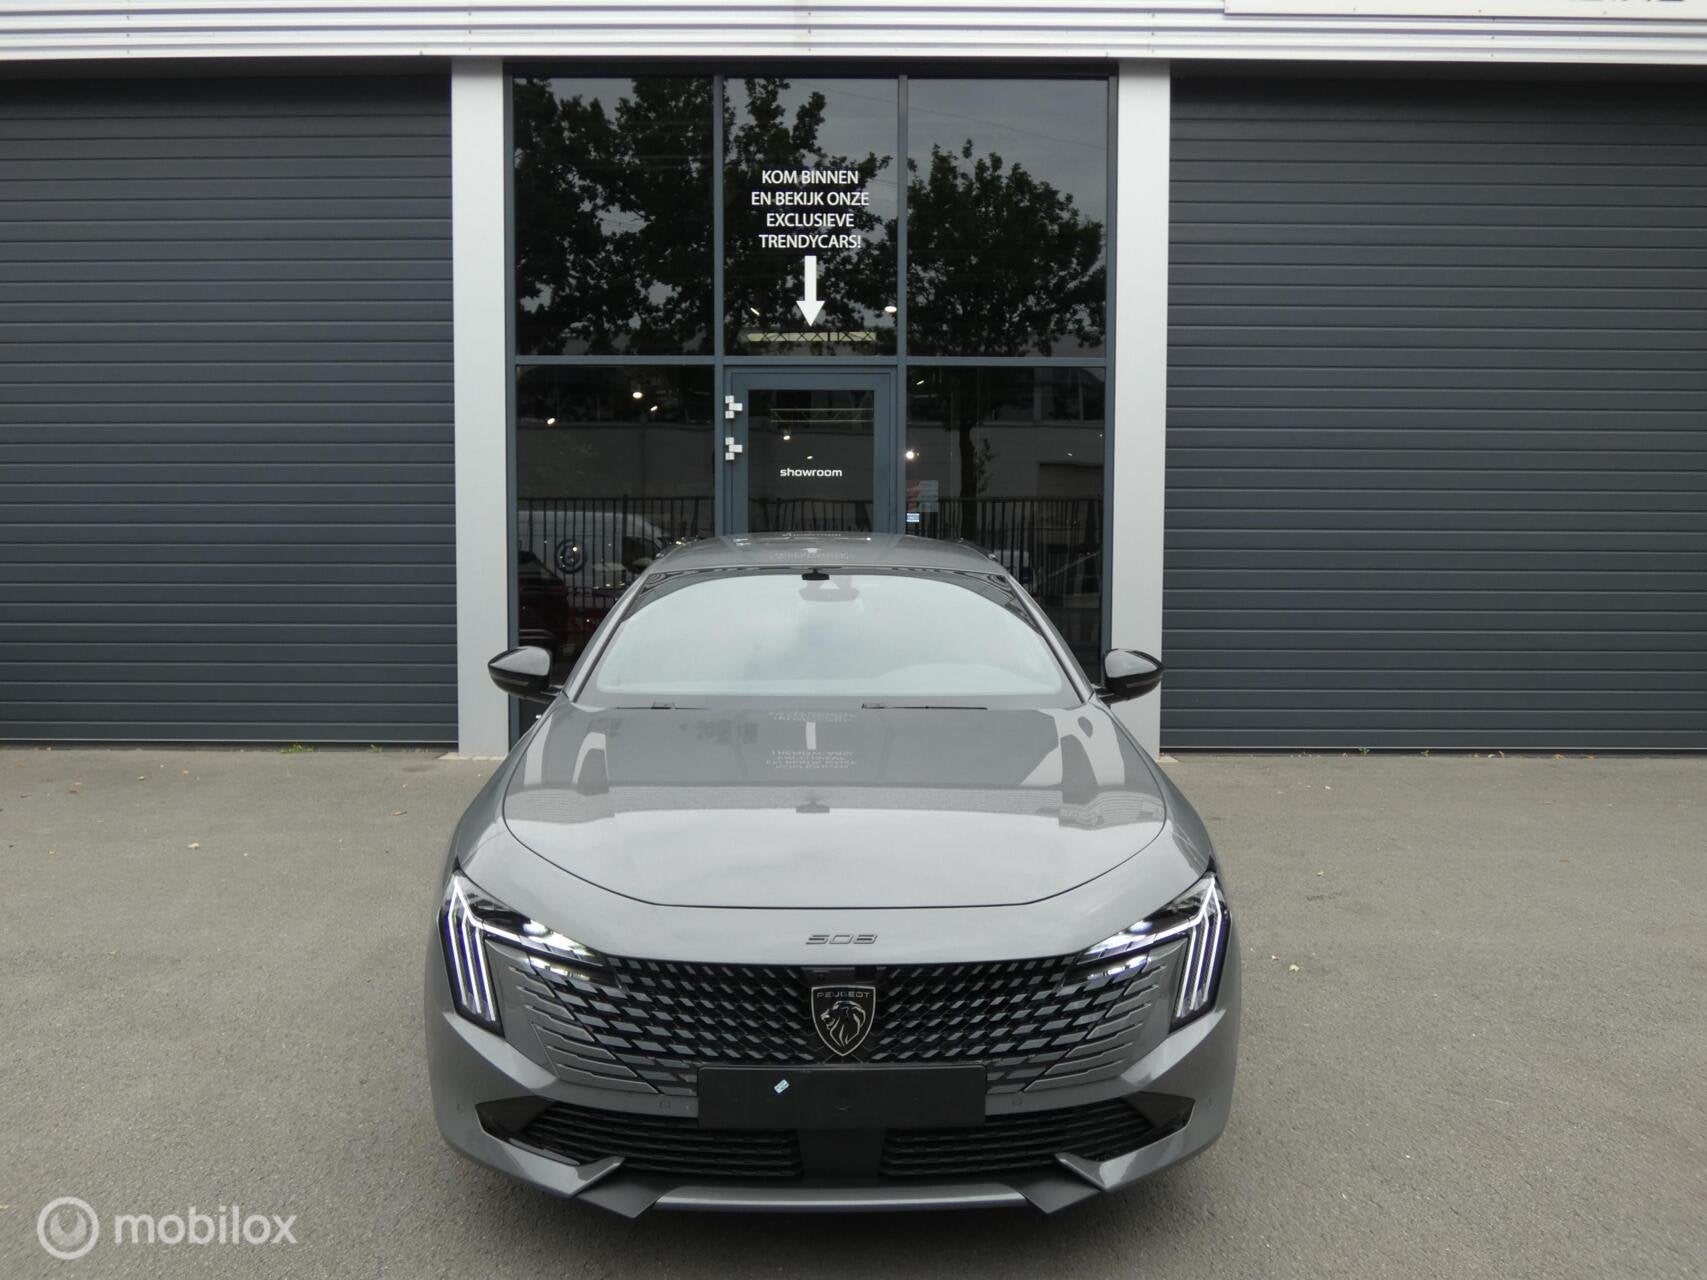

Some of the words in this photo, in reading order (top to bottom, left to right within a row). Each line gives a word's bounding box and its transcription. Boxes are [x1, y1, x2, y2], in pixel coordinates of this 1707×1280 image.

[761, 170, 798, 184] KOM
[801, 170, 859, 184] BINNEN
[751, 192, 772, 206] EN
[775, 192, 824, 206] BEKIJK
[827, 192, 869, 206] ONZE
[766, 213, 854, 227] EXCLUSIEVE
[759, 235, 862, 248] TRENDYCARS!
[780, 467, 843, 477] showroom
[805, 934, 878, 945] 508
